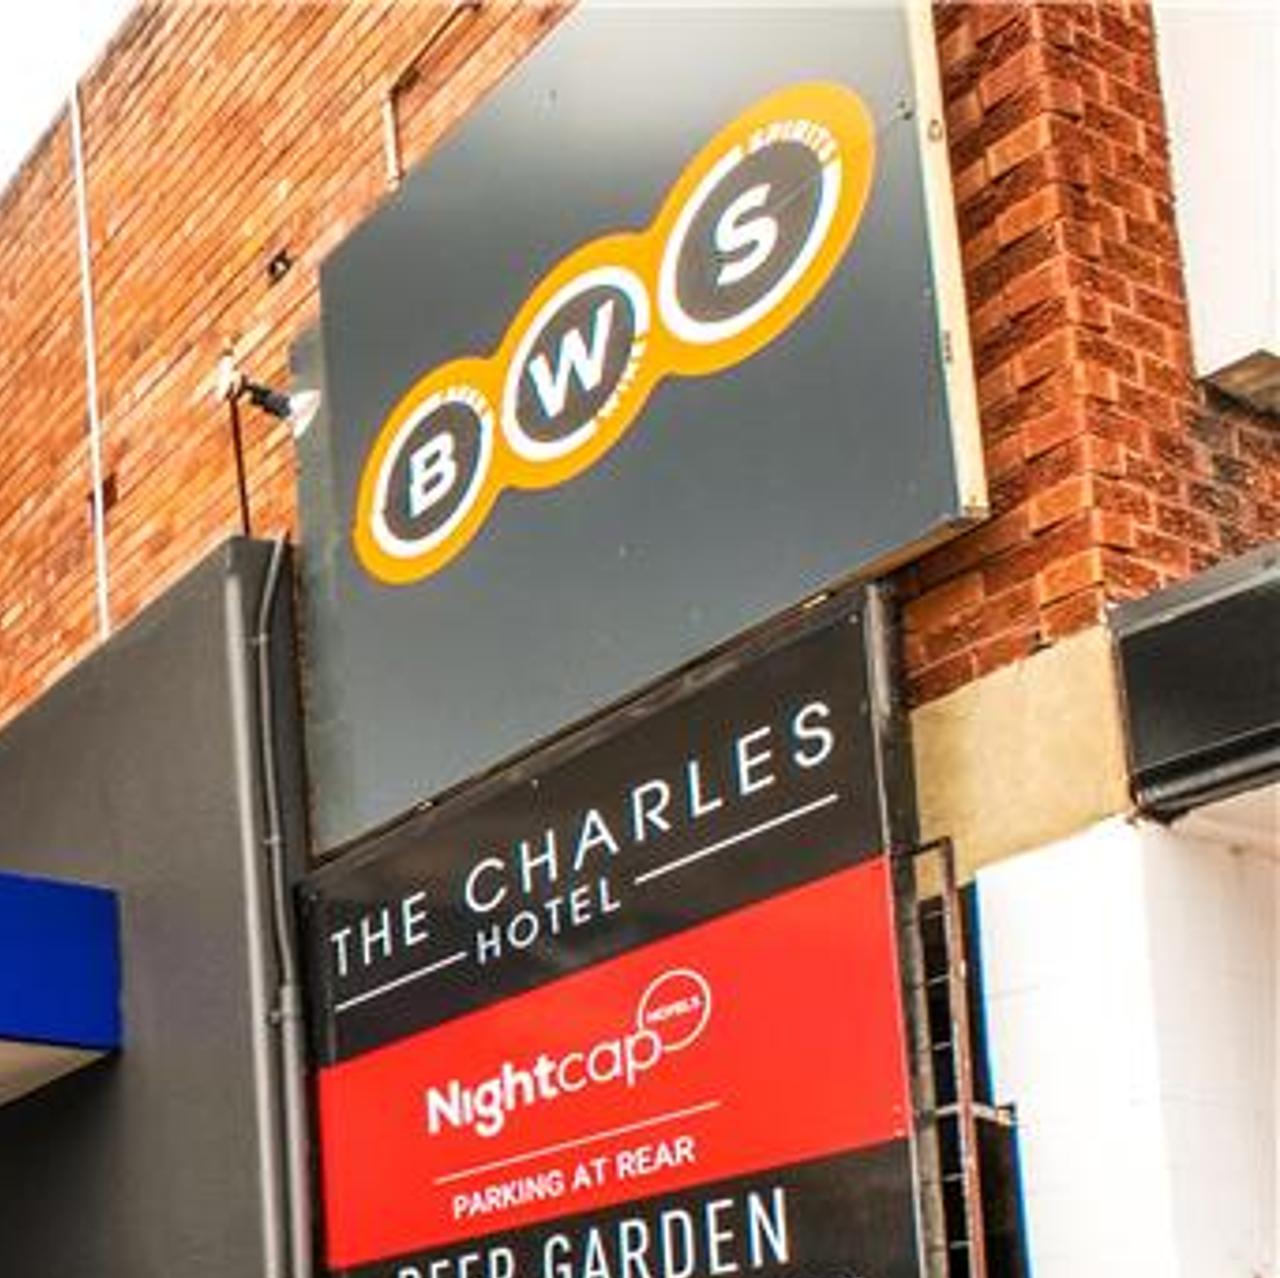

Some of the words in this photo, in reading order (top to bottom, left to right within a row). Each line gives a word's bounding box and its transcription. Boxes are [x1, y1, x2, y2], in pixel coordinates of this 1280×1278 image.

[329, 891, 427, 976] THE
[463, 701, 836, 914] CHARLES
[475, 877, 621, 965] HOTEL
[424, 1027, 663, 1137] Nightcap
[452, 1168, 565, 1221] PARKING
[571, 1157, 608, 1191] AT
[616, 1137, 697, 1181] REAR
